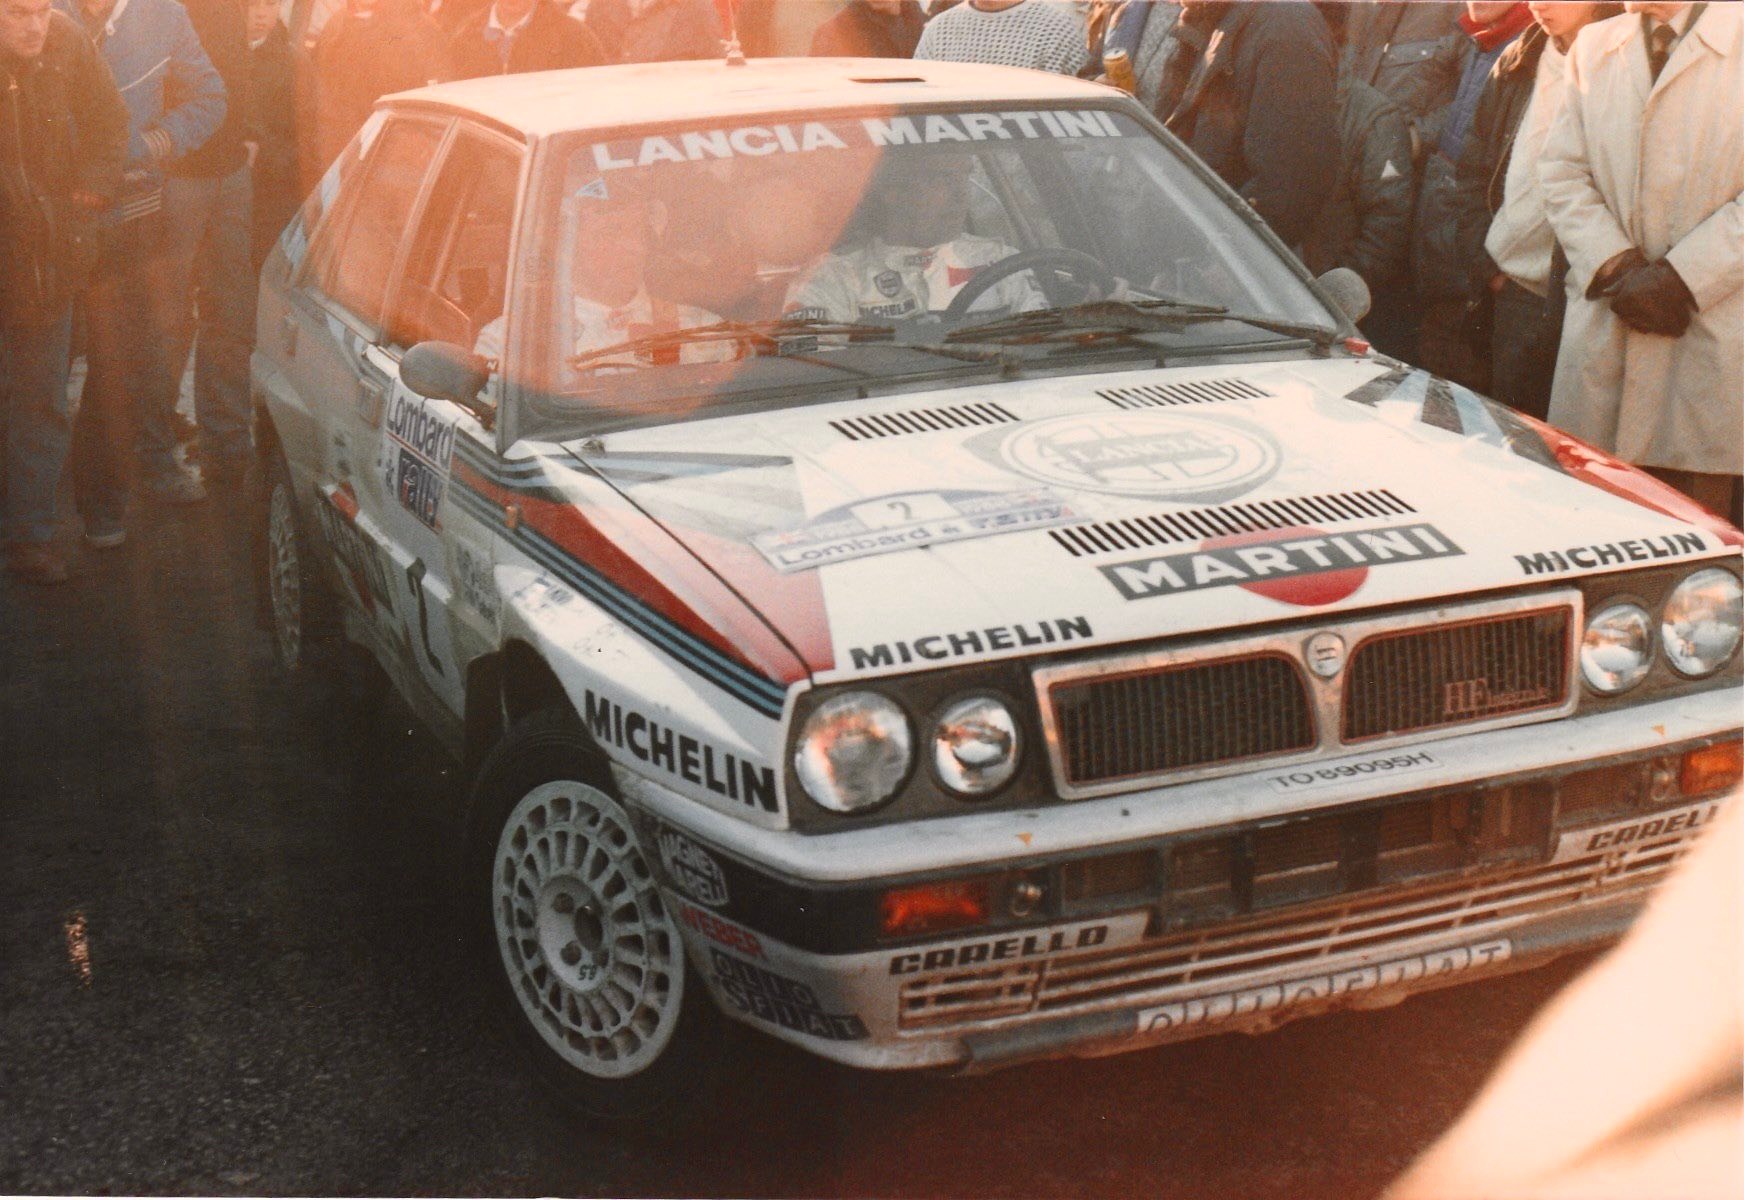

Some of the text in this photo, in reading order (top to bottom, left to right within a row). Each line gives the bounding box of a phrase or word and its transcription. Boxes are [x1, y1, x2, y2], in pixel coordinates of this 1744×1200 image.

[591, 110, 1122, 171] LANCIA MARTINI
[386, 376, 460, 470] Lombard
[777, 526, 932, 566] Lombard
[1112, 527, 1450, 595] MARTINI
[1514, 532, 1707, 575] MICHELIN
[849, 616, 1093, 670] MICHELIN
[585, 689, 780, 813] MICHELIN
[888, 925, 1109, 976] CARELLO
